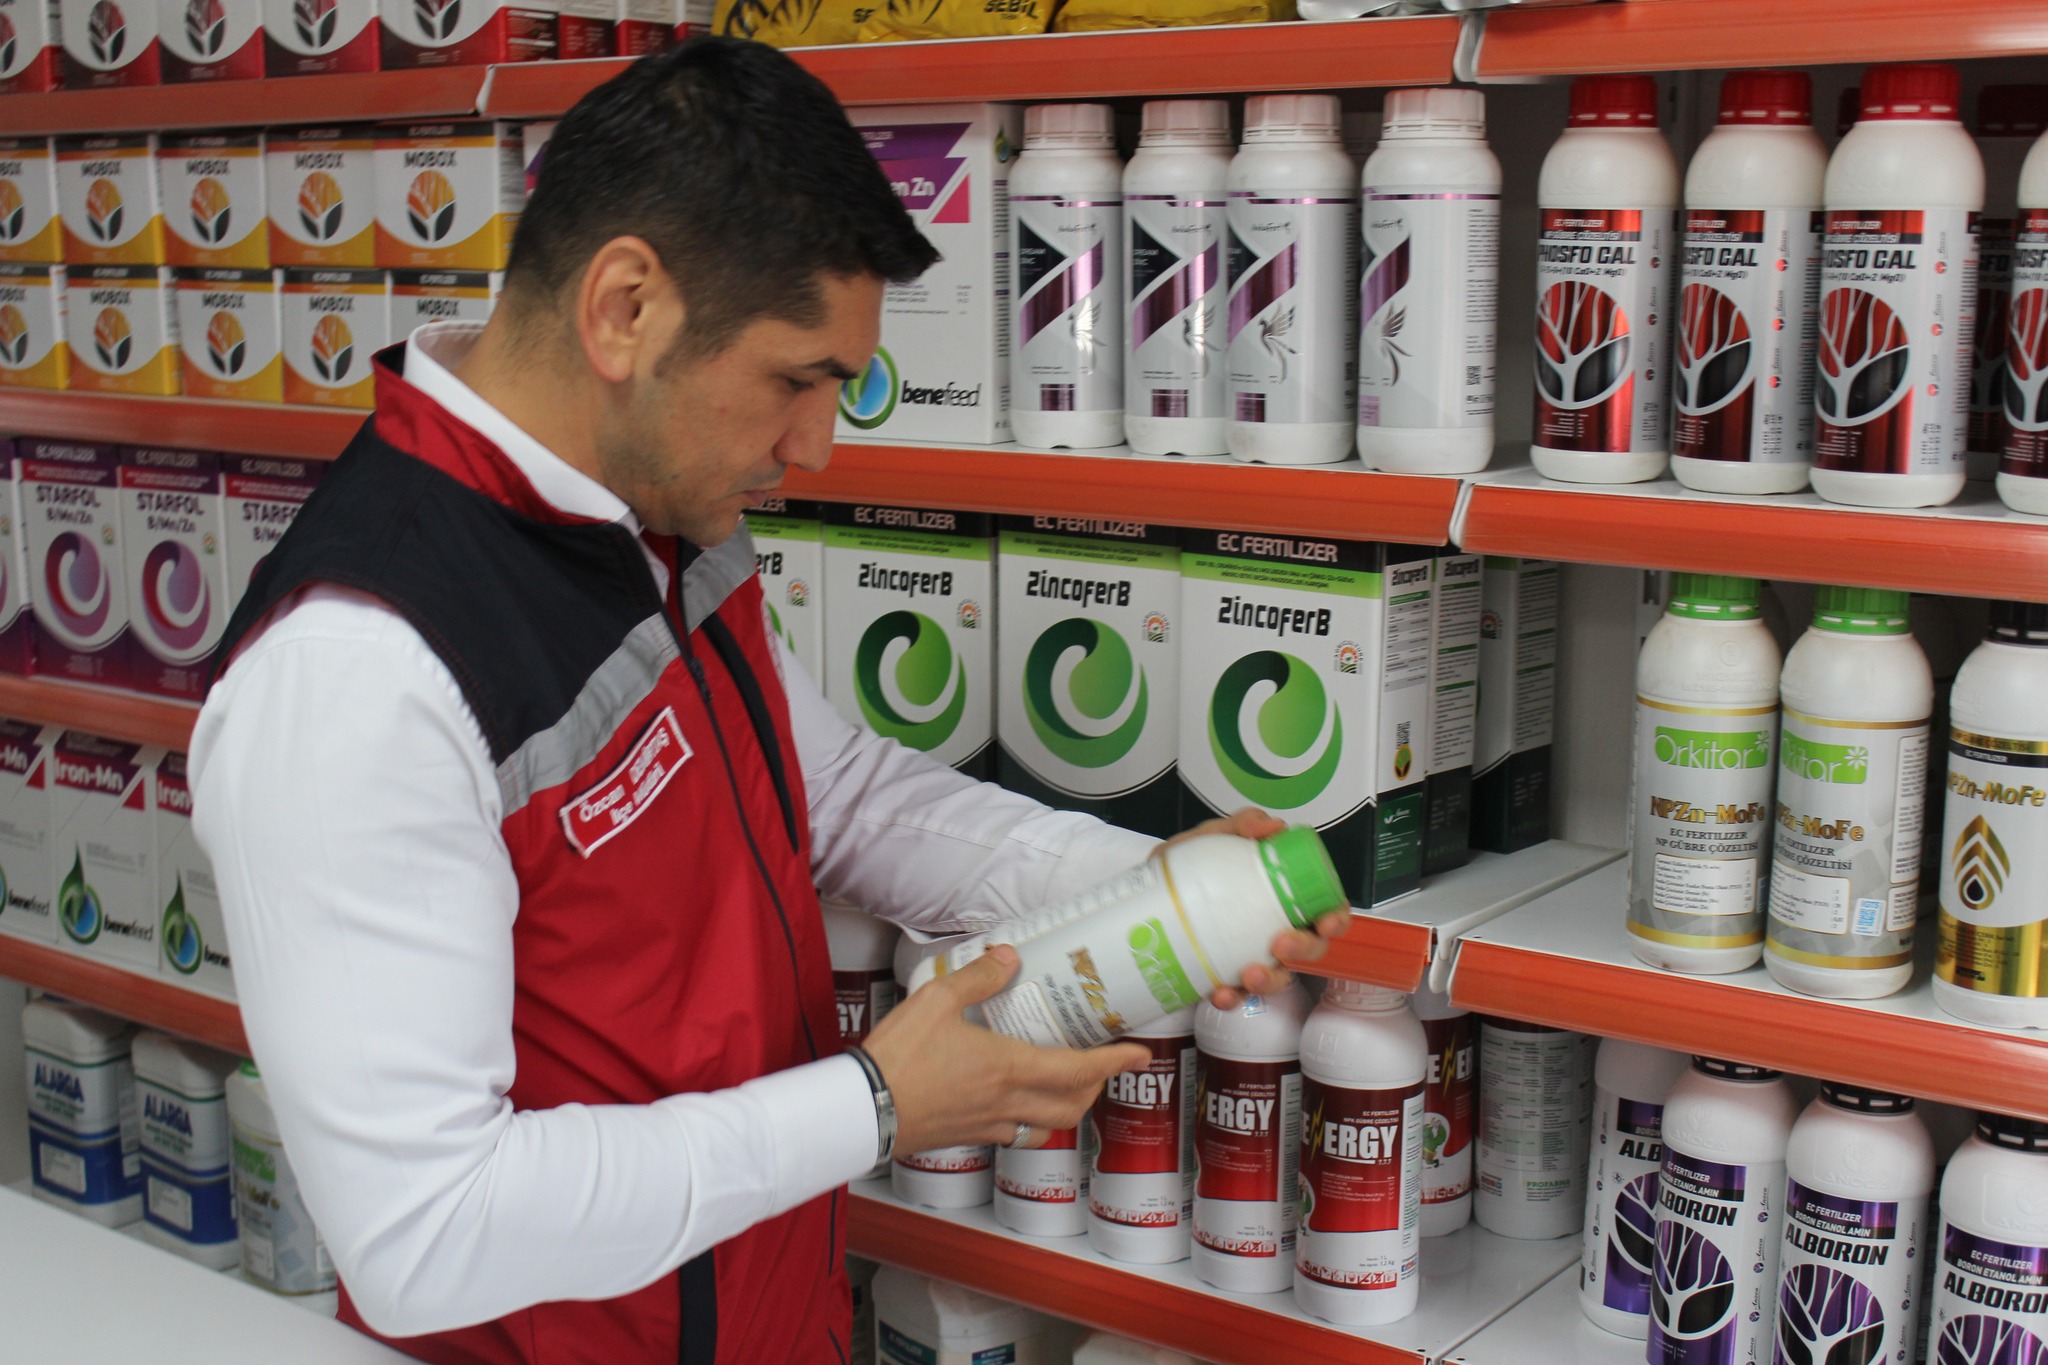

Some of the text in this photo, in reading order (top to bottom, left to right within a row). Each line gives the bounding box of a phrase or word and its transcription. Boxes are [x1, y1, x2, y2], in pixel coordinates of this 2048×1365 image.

[404, 151, 457, 170] MOBOX
[911, 177, 935, 197] Zn
[901, 379, 981, 407] benefeed
[36, 485, 101, 508] STARFOL
[137, 492, 205, 516] STARFOL
[854, 507, 956, 531] EC FERTILIZER
[1217, 533, 1338, 563] EC FERTILIZER
[1655, 734, 1753, 769] Orkitar
[54, 758, 123, 791] Iron-Mn
[1686, 830, 1748, 841] FERTILIZER
[1674, 1165, 1711, 1183] FERTILIZER
[1674, 1178, 1697, 1193] ETANOL
[1698, 1187, 1719, 1198] AMIN
[1660, 1185, 1737, 1226] LBORON
[1806, 1202, 1861, 1223] EC FERTILIZER
[1816, 1218, 1846, 1235] ETANOL
[1847, 1227, 1871, 1238] AMIN
[1785, 1222, 1889, 1266] ALBORON
[1970, 1250, 2033, 1270] EC FERTILIZER
[1957, 1259, 2043, 1285] BORON ETANOL AMIN
